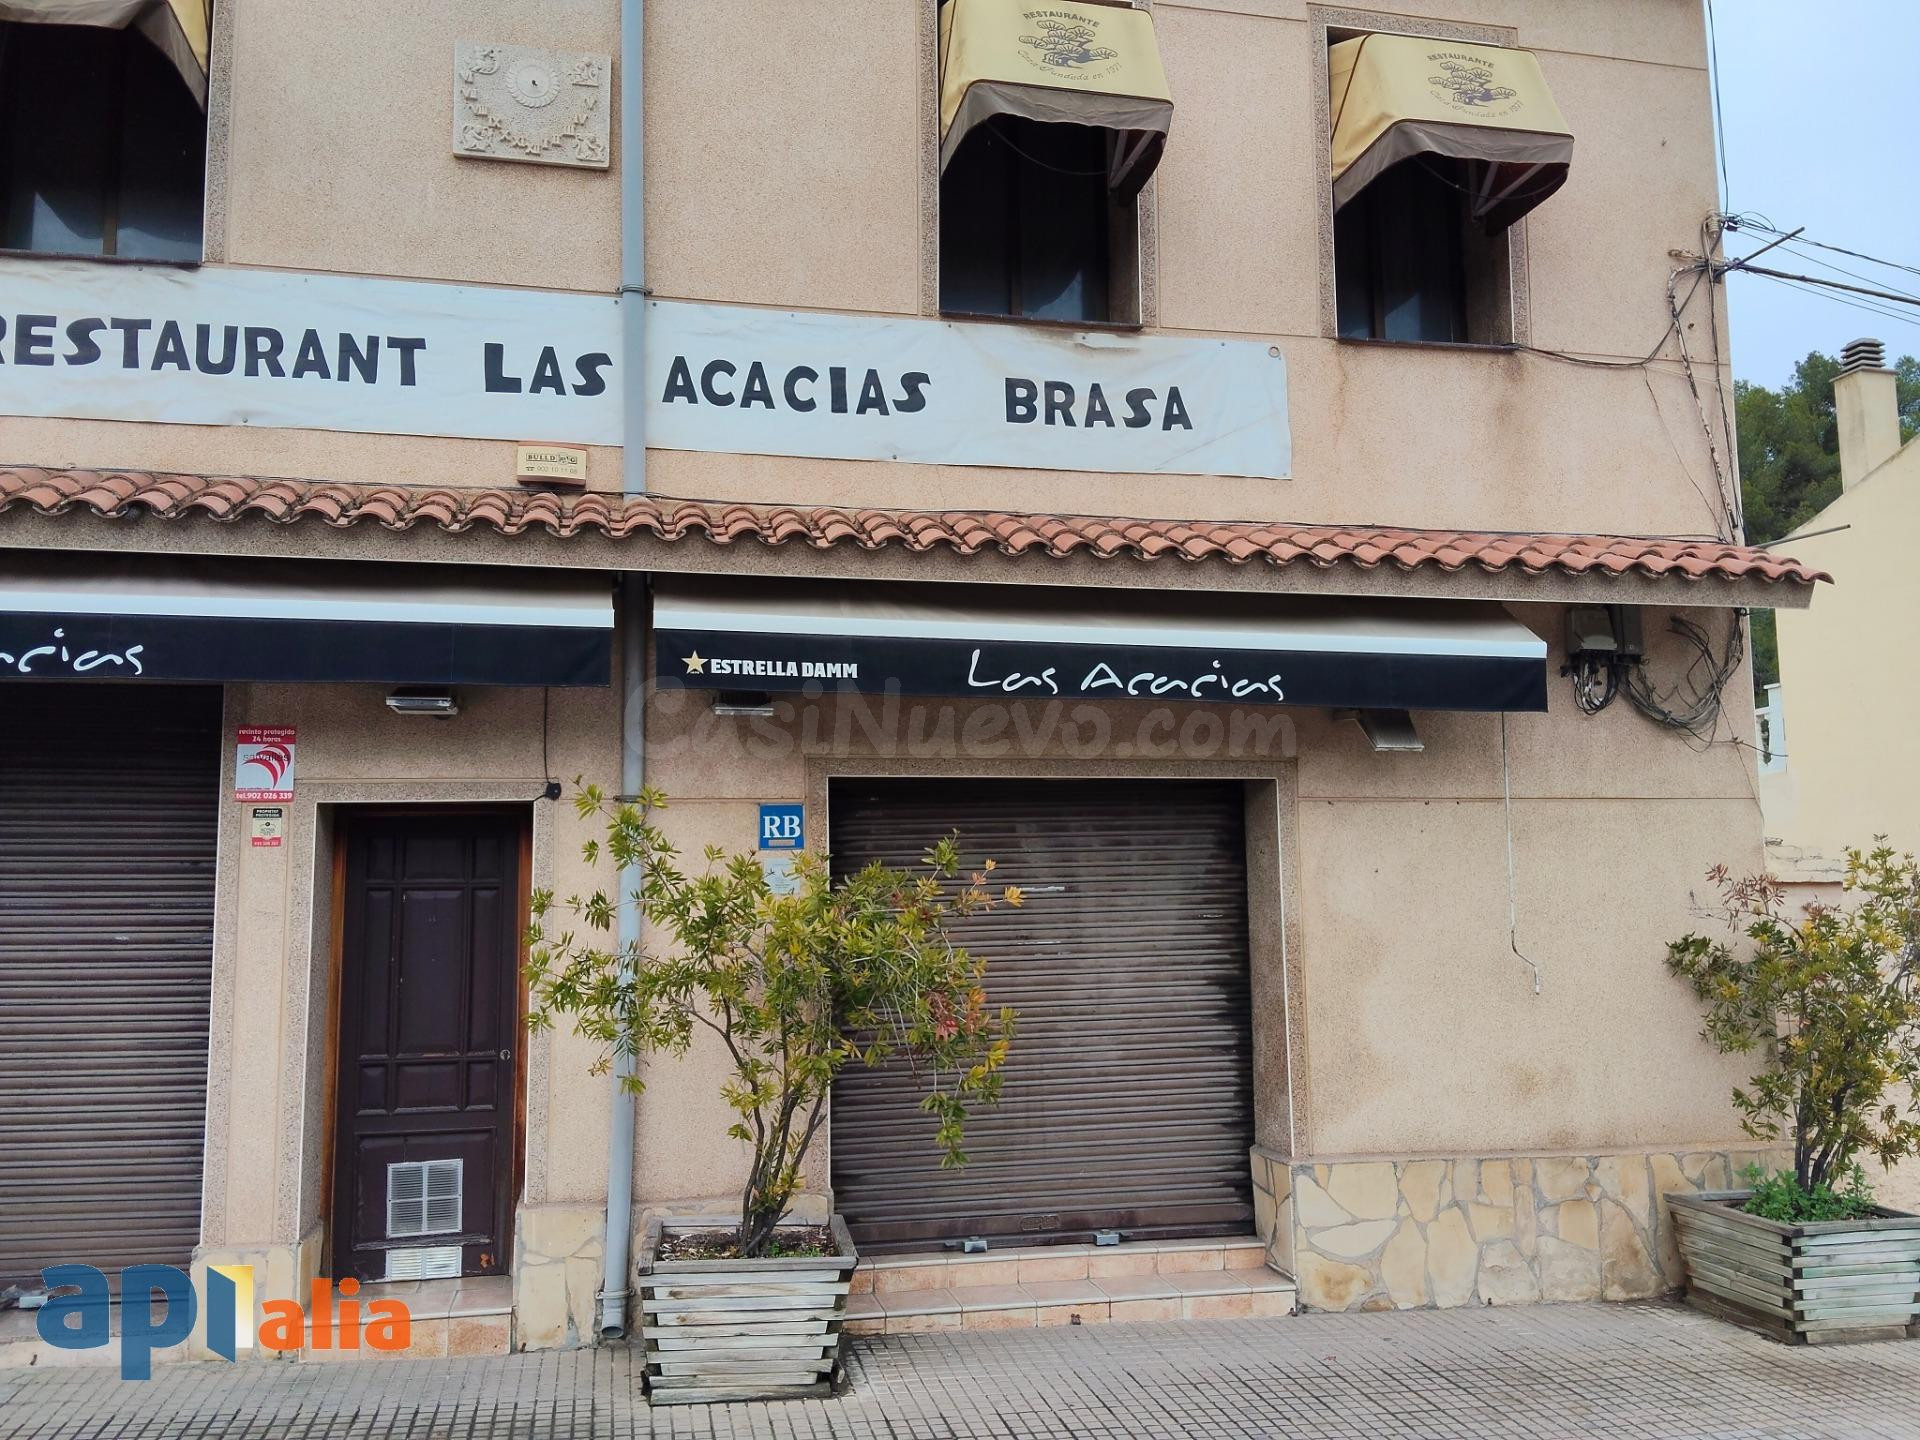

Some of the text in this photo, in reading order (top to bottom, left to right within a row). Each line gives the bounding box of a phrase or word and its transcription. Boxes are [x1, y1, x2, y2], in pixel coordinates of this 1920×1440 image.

[1023, 10, 1100, 28] RESTAURANTE
[1427, 52, 1495, 69] RESTAURANTE
[0, 314, 1193, 431] ESTAURANT LAS ACACIAS BRASA
[0, 628, 143, 675] cias
[711, 658, 857, 678] ESTRELLA DAMM
[968, 649, 1284, 701] Las Acacias
[263, 728, 295, 736] protegido
[762, 815, 800, 838] RB
